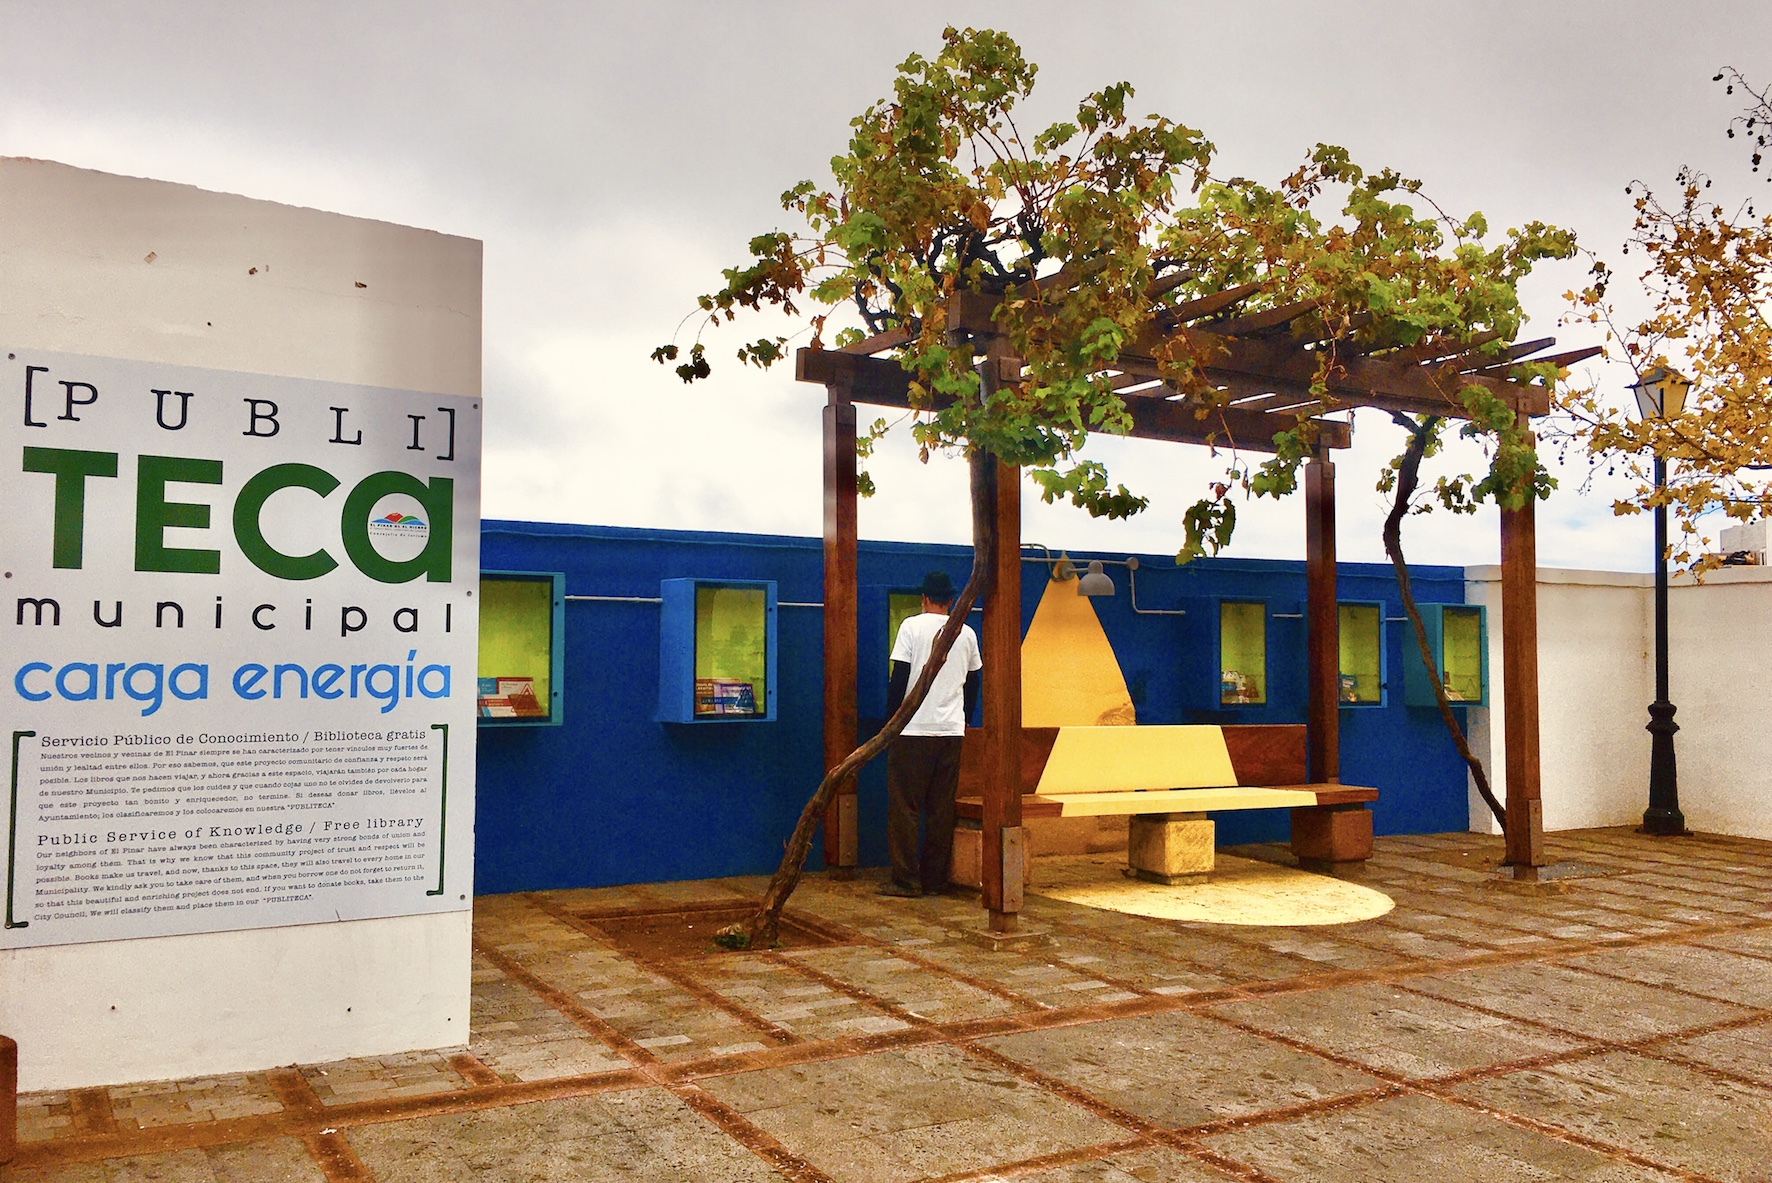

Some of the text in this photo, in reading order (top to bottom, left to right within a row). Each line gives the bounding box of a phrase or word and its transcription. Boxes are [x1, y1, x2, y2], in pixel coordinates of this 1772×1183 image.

[16, 596, 451, 637] municipal
[15, 650, 451, 717] carga energía
[40, 734, 108, 747] Servicio
[112, 733, 171, 746] Público
[175, 733, 194, 744] de
[198, 731, 299, 744] Conocimiento
[313, 729, 383, 741] Biblioteca
[386, 729, 426, 742] gratis
[36, 832, 98, 846] Public
[106, 828, 177, 842] Service
[184, 826, 203, 839] of
[208, 822, 302, 839] Knowledge
[323, 819, 360, 831] Free
[366, 815, 423, 831] library
[35, 862, 66, 872] loyalty
[69, 861, 97, 870] among
[254, 849, 296, 859] community
[298, 848, 324, 856] project
[373, 843, 400, 851] respect
[55, 848, 96, 858] neighbors
[122, 846, 144, 854] Pinar
[169, 843, 196, 852] always
[198, 842, 217, 850] been
[219, 839, 272, 848] characterized
[286, 837, 312, 845] having
[74, 873, 99, 881] Books
[101, 871, 123, 879] make
[281, 860, 298, 869] they
[105, 882, 132, 892] kindly
[297, 870, 324, 878] borrow
[362, 866, 383, 874] forget
[46, 899, 64, 907] that
[66, 898, 83, 906] this
[84, 895, 122, 905] beautiful
[141, 891, 180, 902] enriching
[181, 890, 209, 899] project
[211, 888, 229, 896] does
[271, 885, 286, 893] you
[317, 880, 342, 888] donate
[33, 913, 52, 922] City
[120, 905, 152, 916] classify
[153, 904, 174, 912] them
[192, 901, 213, 910] place
[214, 899, 234, 907] them
